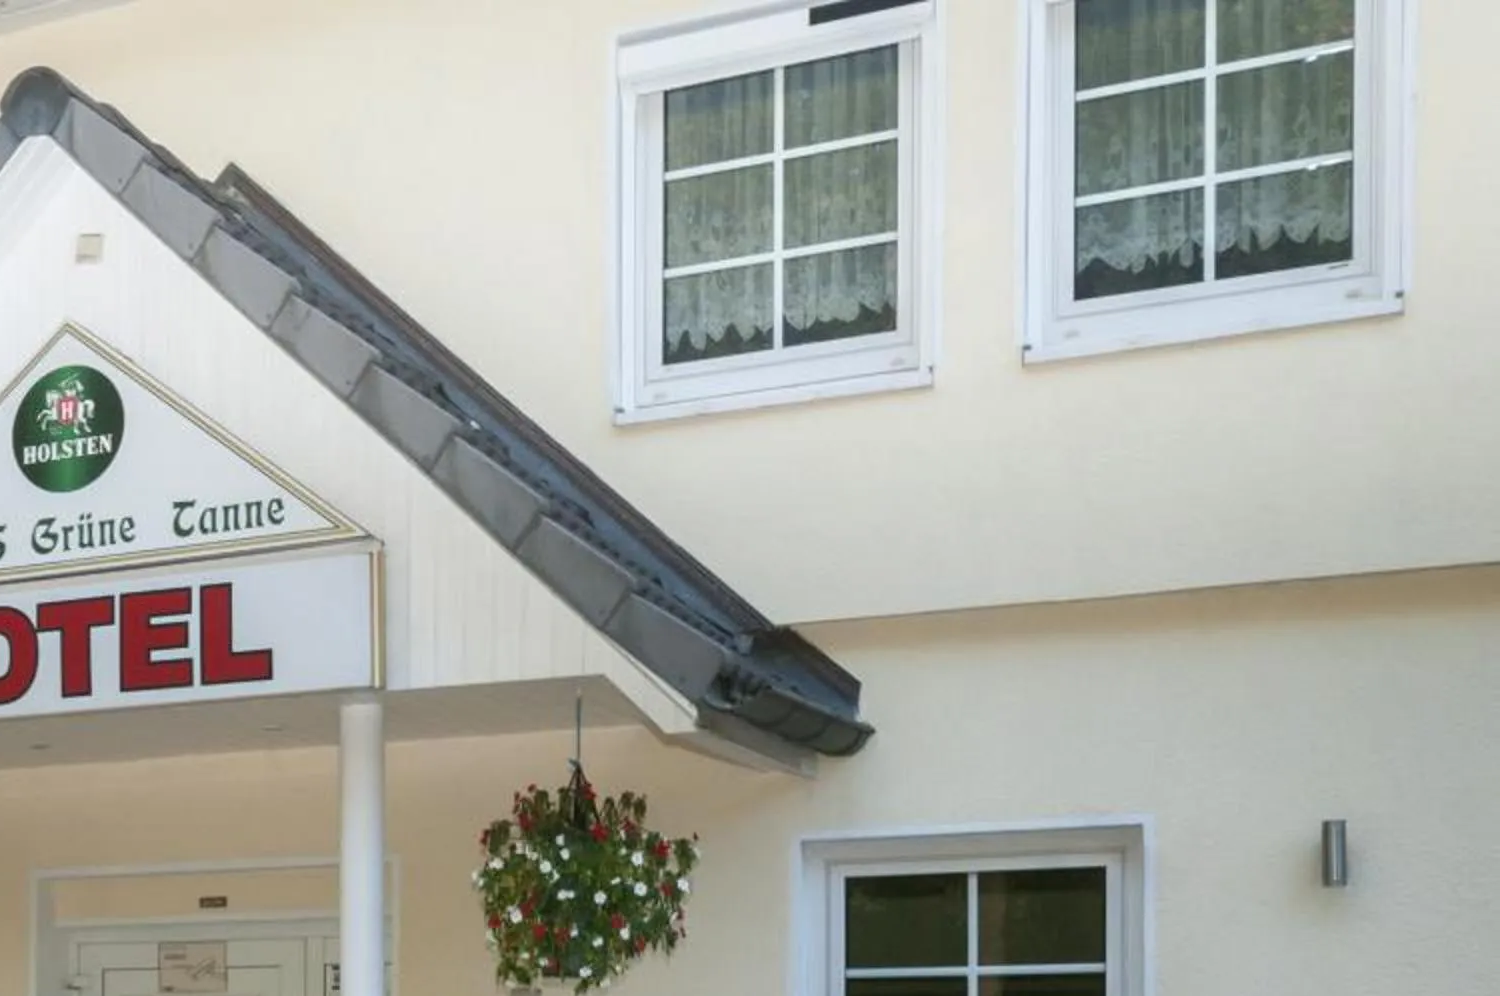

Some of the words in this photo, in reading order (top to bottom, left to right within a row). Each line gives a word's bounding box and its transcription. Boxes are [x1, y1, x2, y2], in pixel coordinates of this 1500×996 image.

[61, 400, 74, 421] H
[23, 433, 113, 465] HOLSTEN
[31, 513, 136, 555] Grüne
[172, 497, 285, 537] Tanne
